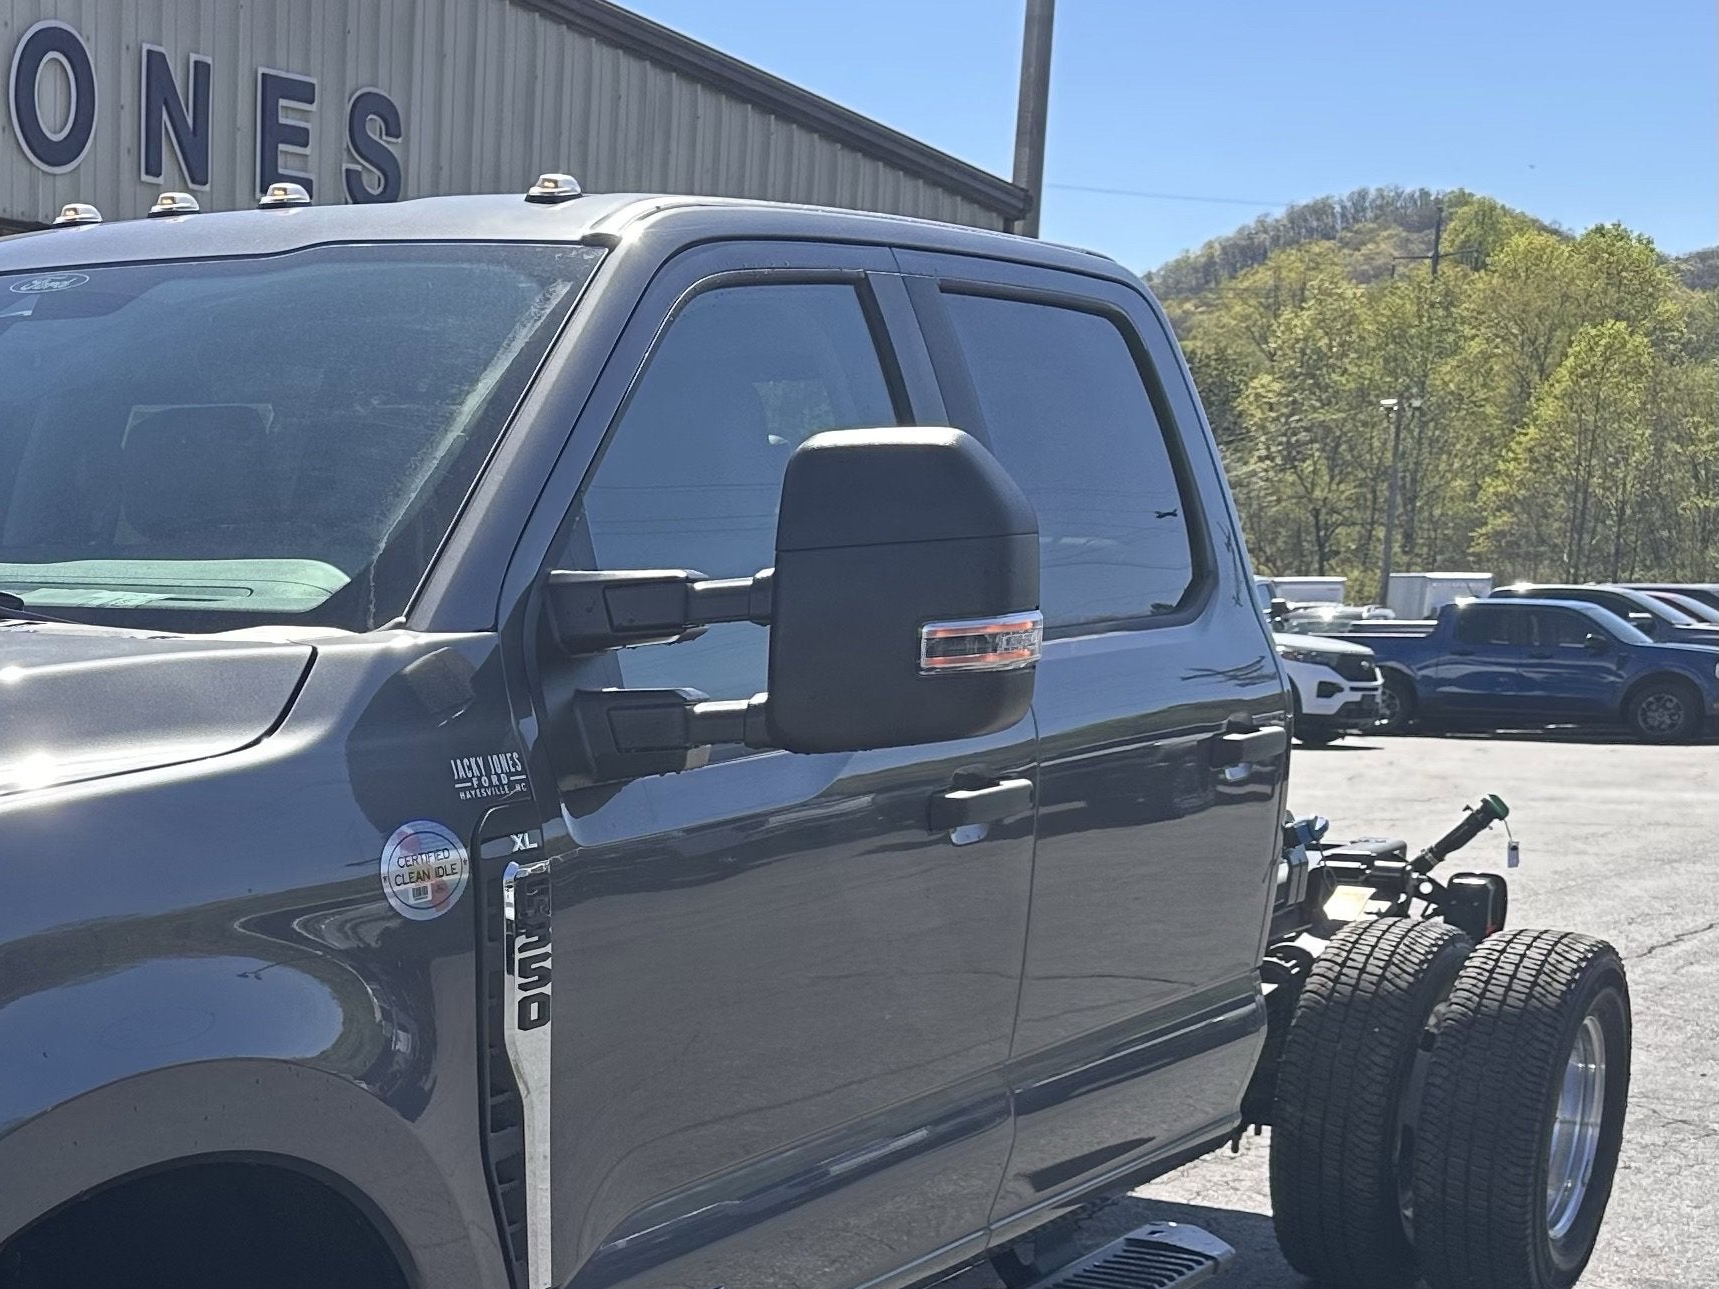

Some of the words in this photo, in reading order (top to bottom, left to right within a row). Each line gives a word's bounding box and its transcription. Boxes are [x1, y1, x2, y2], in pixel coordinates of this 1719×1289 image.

[450, 756, 486, 780] JACKY
[488, 751, 522, 775] JONES
[472, 773, 509, 788] FORD
[510, 832, 538, 852] XL
[396, 847, 451, 868] CERTIFIED
[394, 868, 431, 887] CLEAN
[435, 863, 459, 879] IDLE
